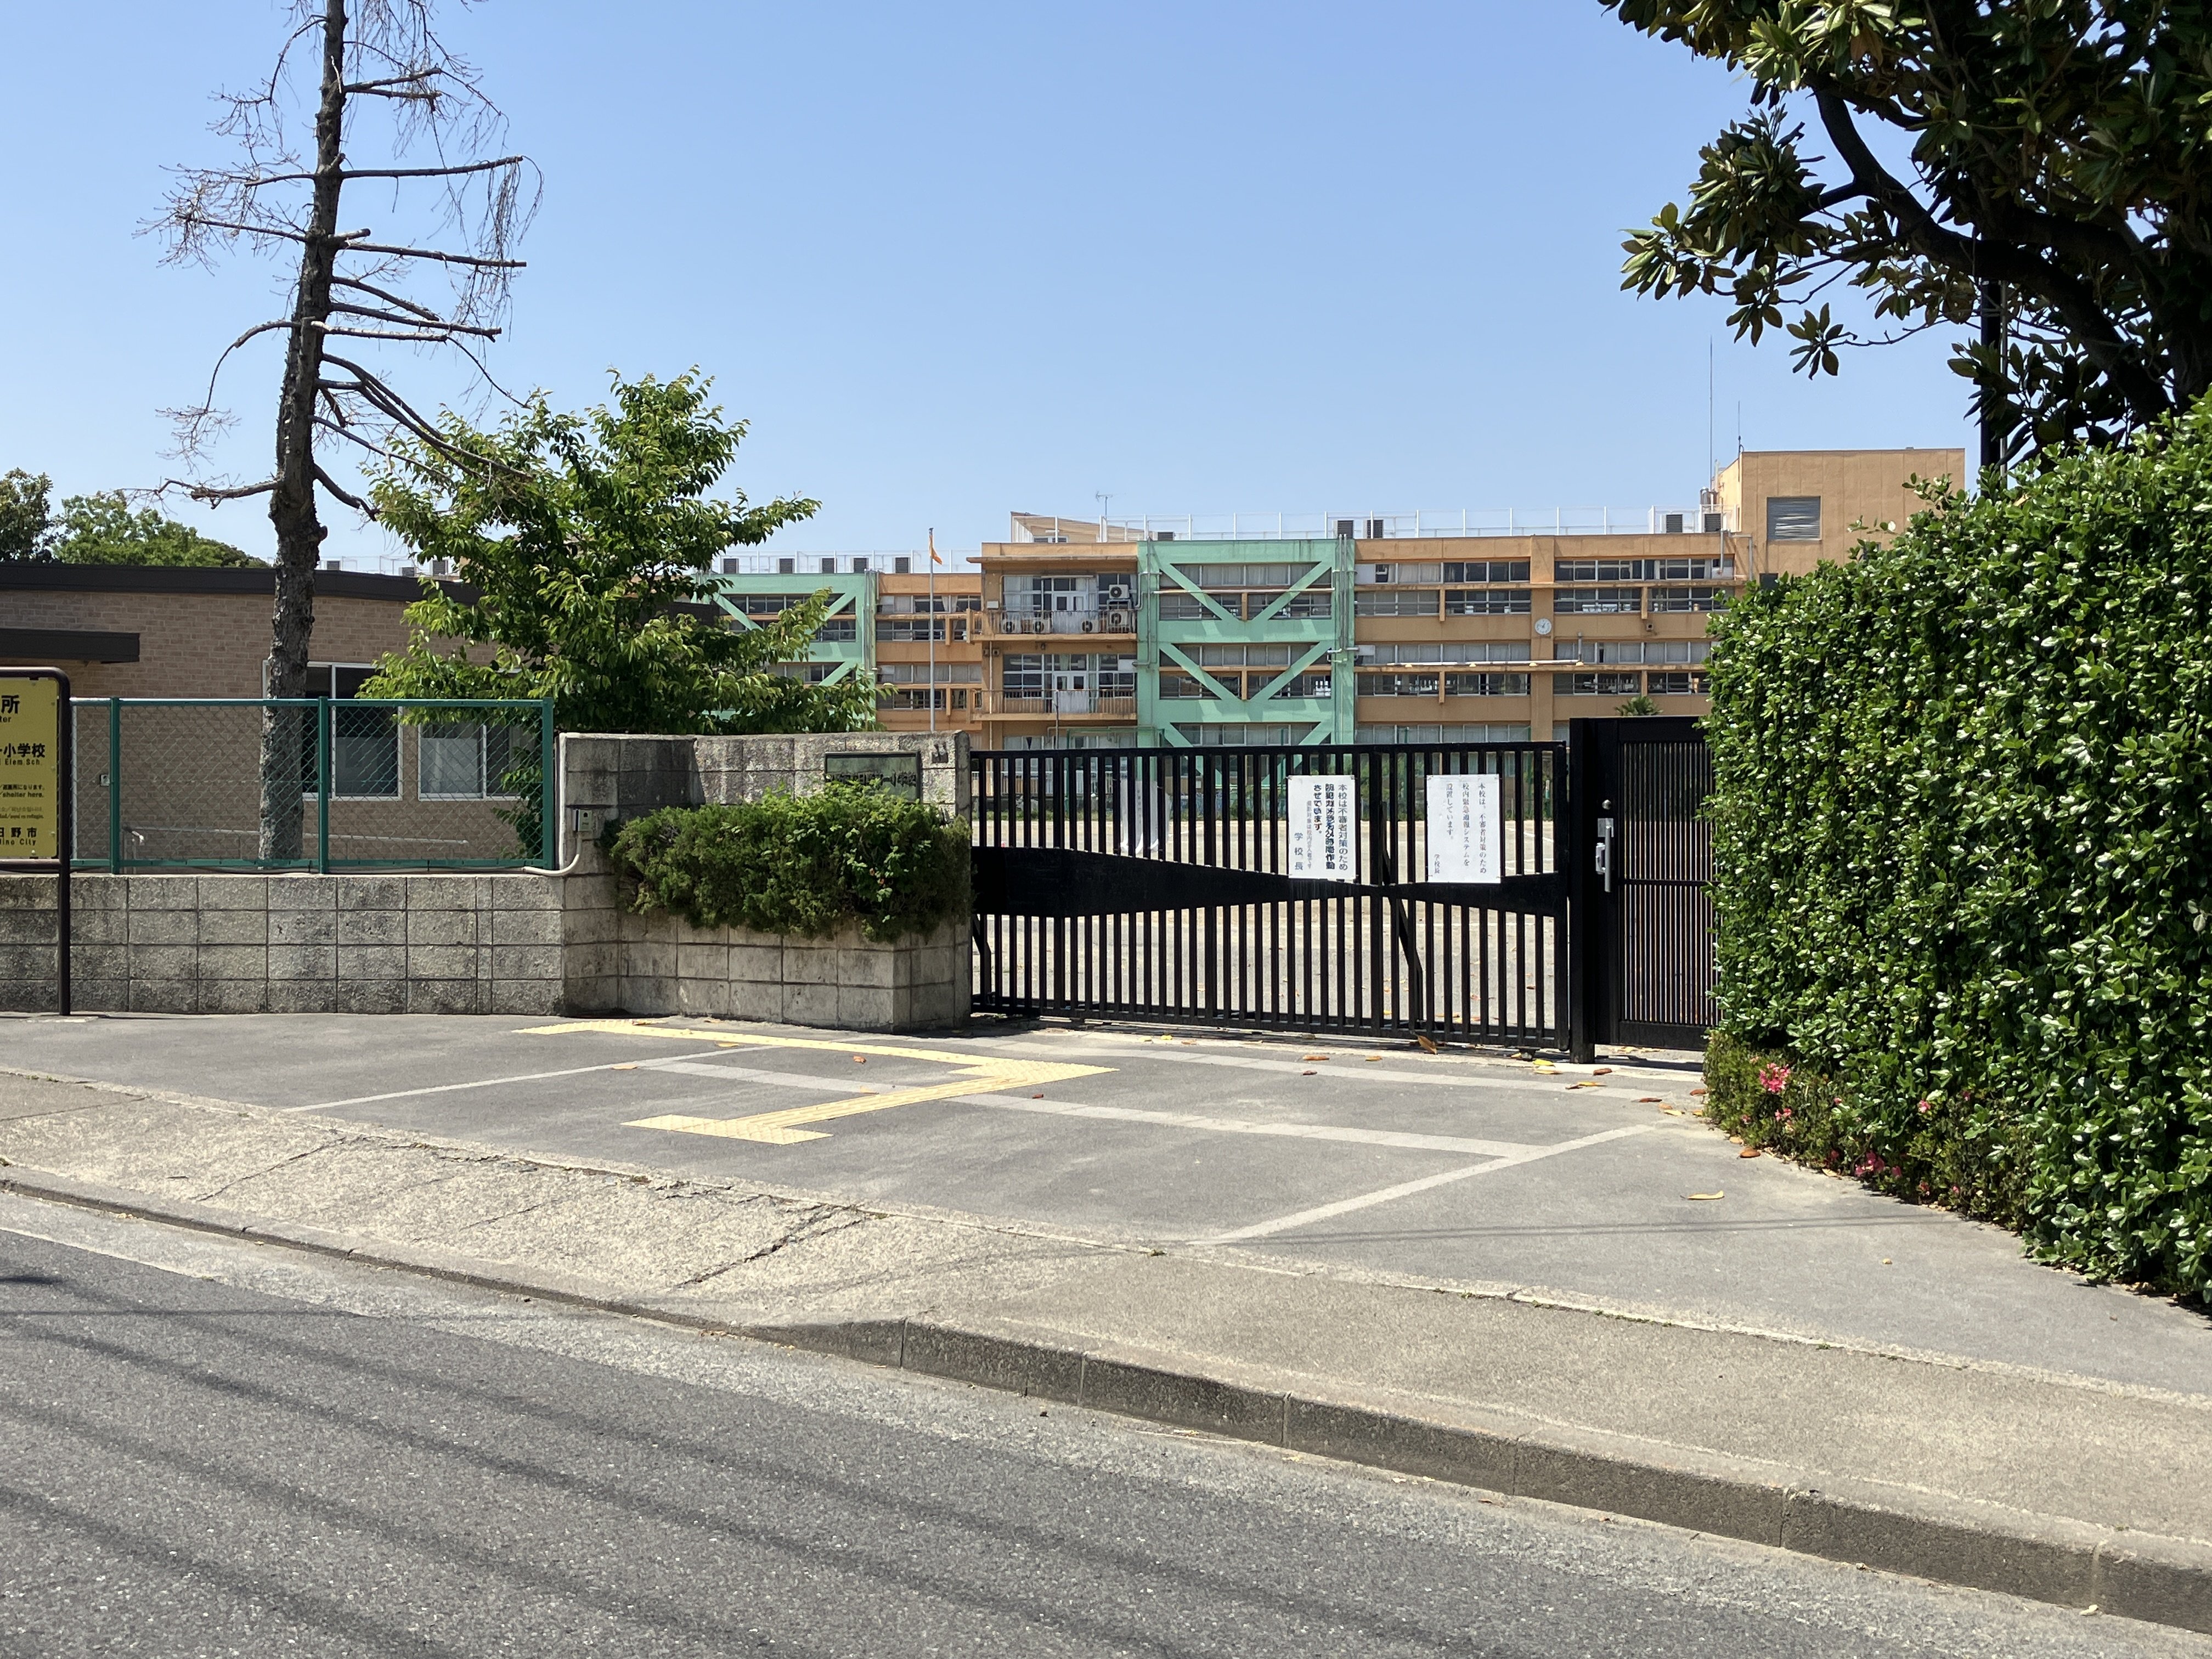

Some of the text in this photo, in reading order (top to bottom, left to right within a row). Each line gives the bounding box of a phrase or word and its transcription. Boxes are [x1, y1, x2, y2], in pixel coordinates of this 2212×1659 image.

[1, 695, 20, 714] 所
[0, 743, 46, 758] 小学校
[0, 837, 36, 846] ino City
[1294, 832, 1304, 871] 学校長
